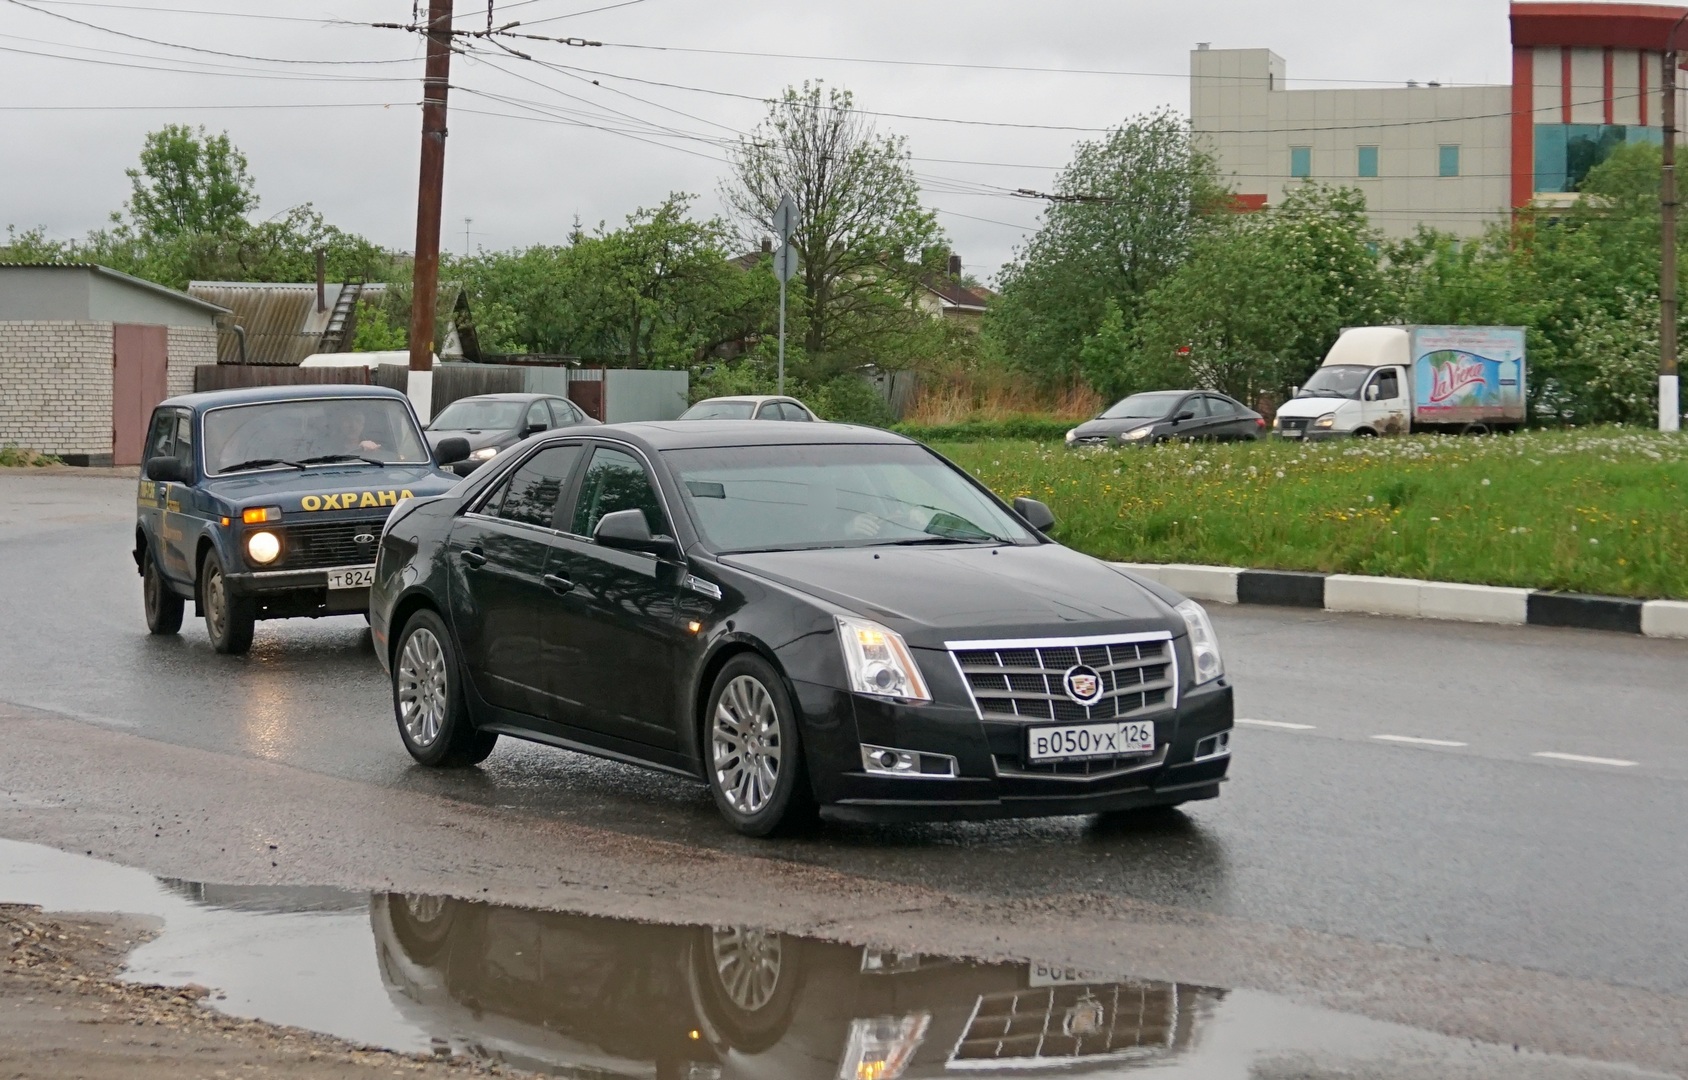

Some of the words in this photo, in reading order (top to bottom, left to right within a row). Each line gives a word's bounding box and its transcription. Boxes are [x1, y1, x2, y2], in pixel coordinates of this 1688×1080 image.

[301, 489, 415, 512] ОХРАНА
[1037, 730, 1117, 754] В050УХ
[1120, 724, 1149, 742] 126
